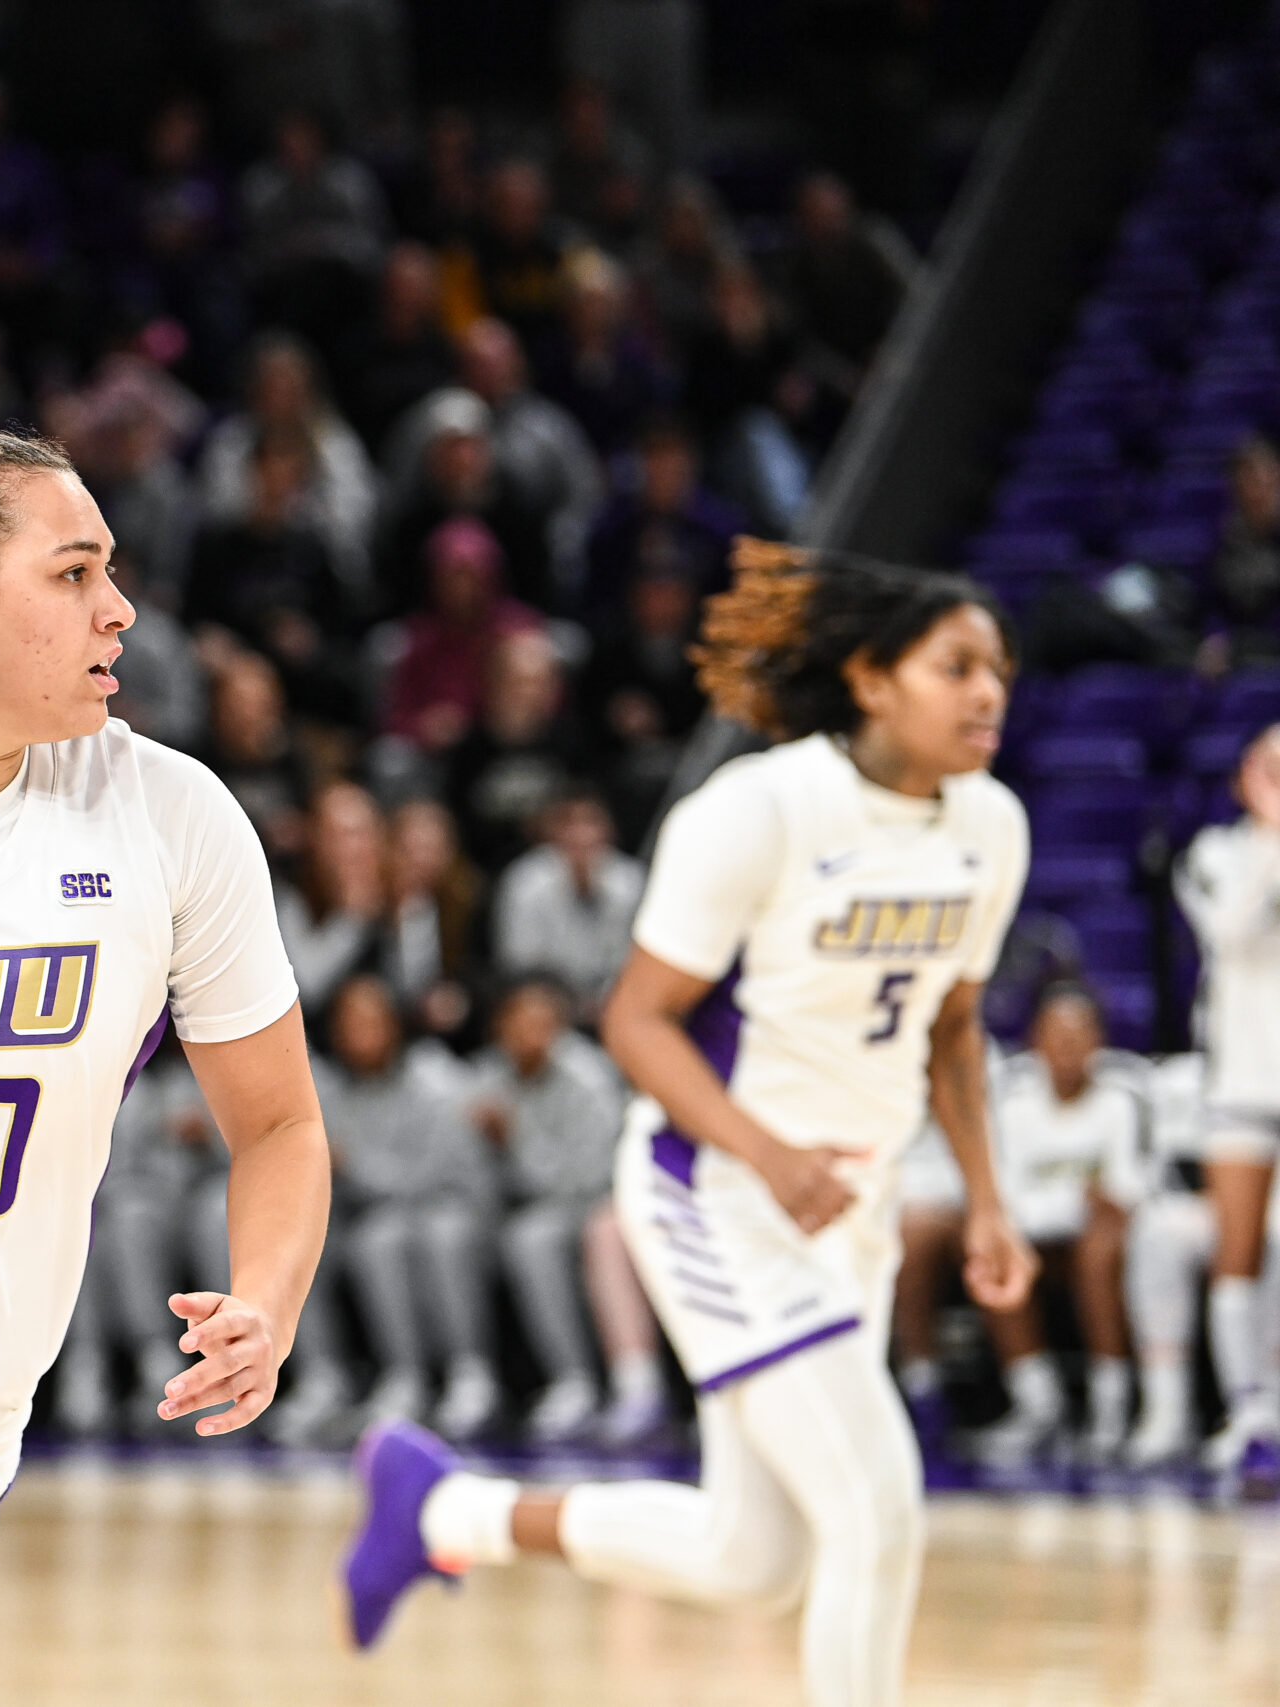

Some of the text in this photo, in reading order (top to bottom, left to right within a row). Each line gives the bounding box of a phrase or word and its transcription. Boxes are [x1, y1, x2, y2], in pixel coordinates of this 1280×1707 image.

[60, 873, 112, 898] SBC
[815, 898, 972, 956] JMU
[865, 971, 915, 1044] 5
